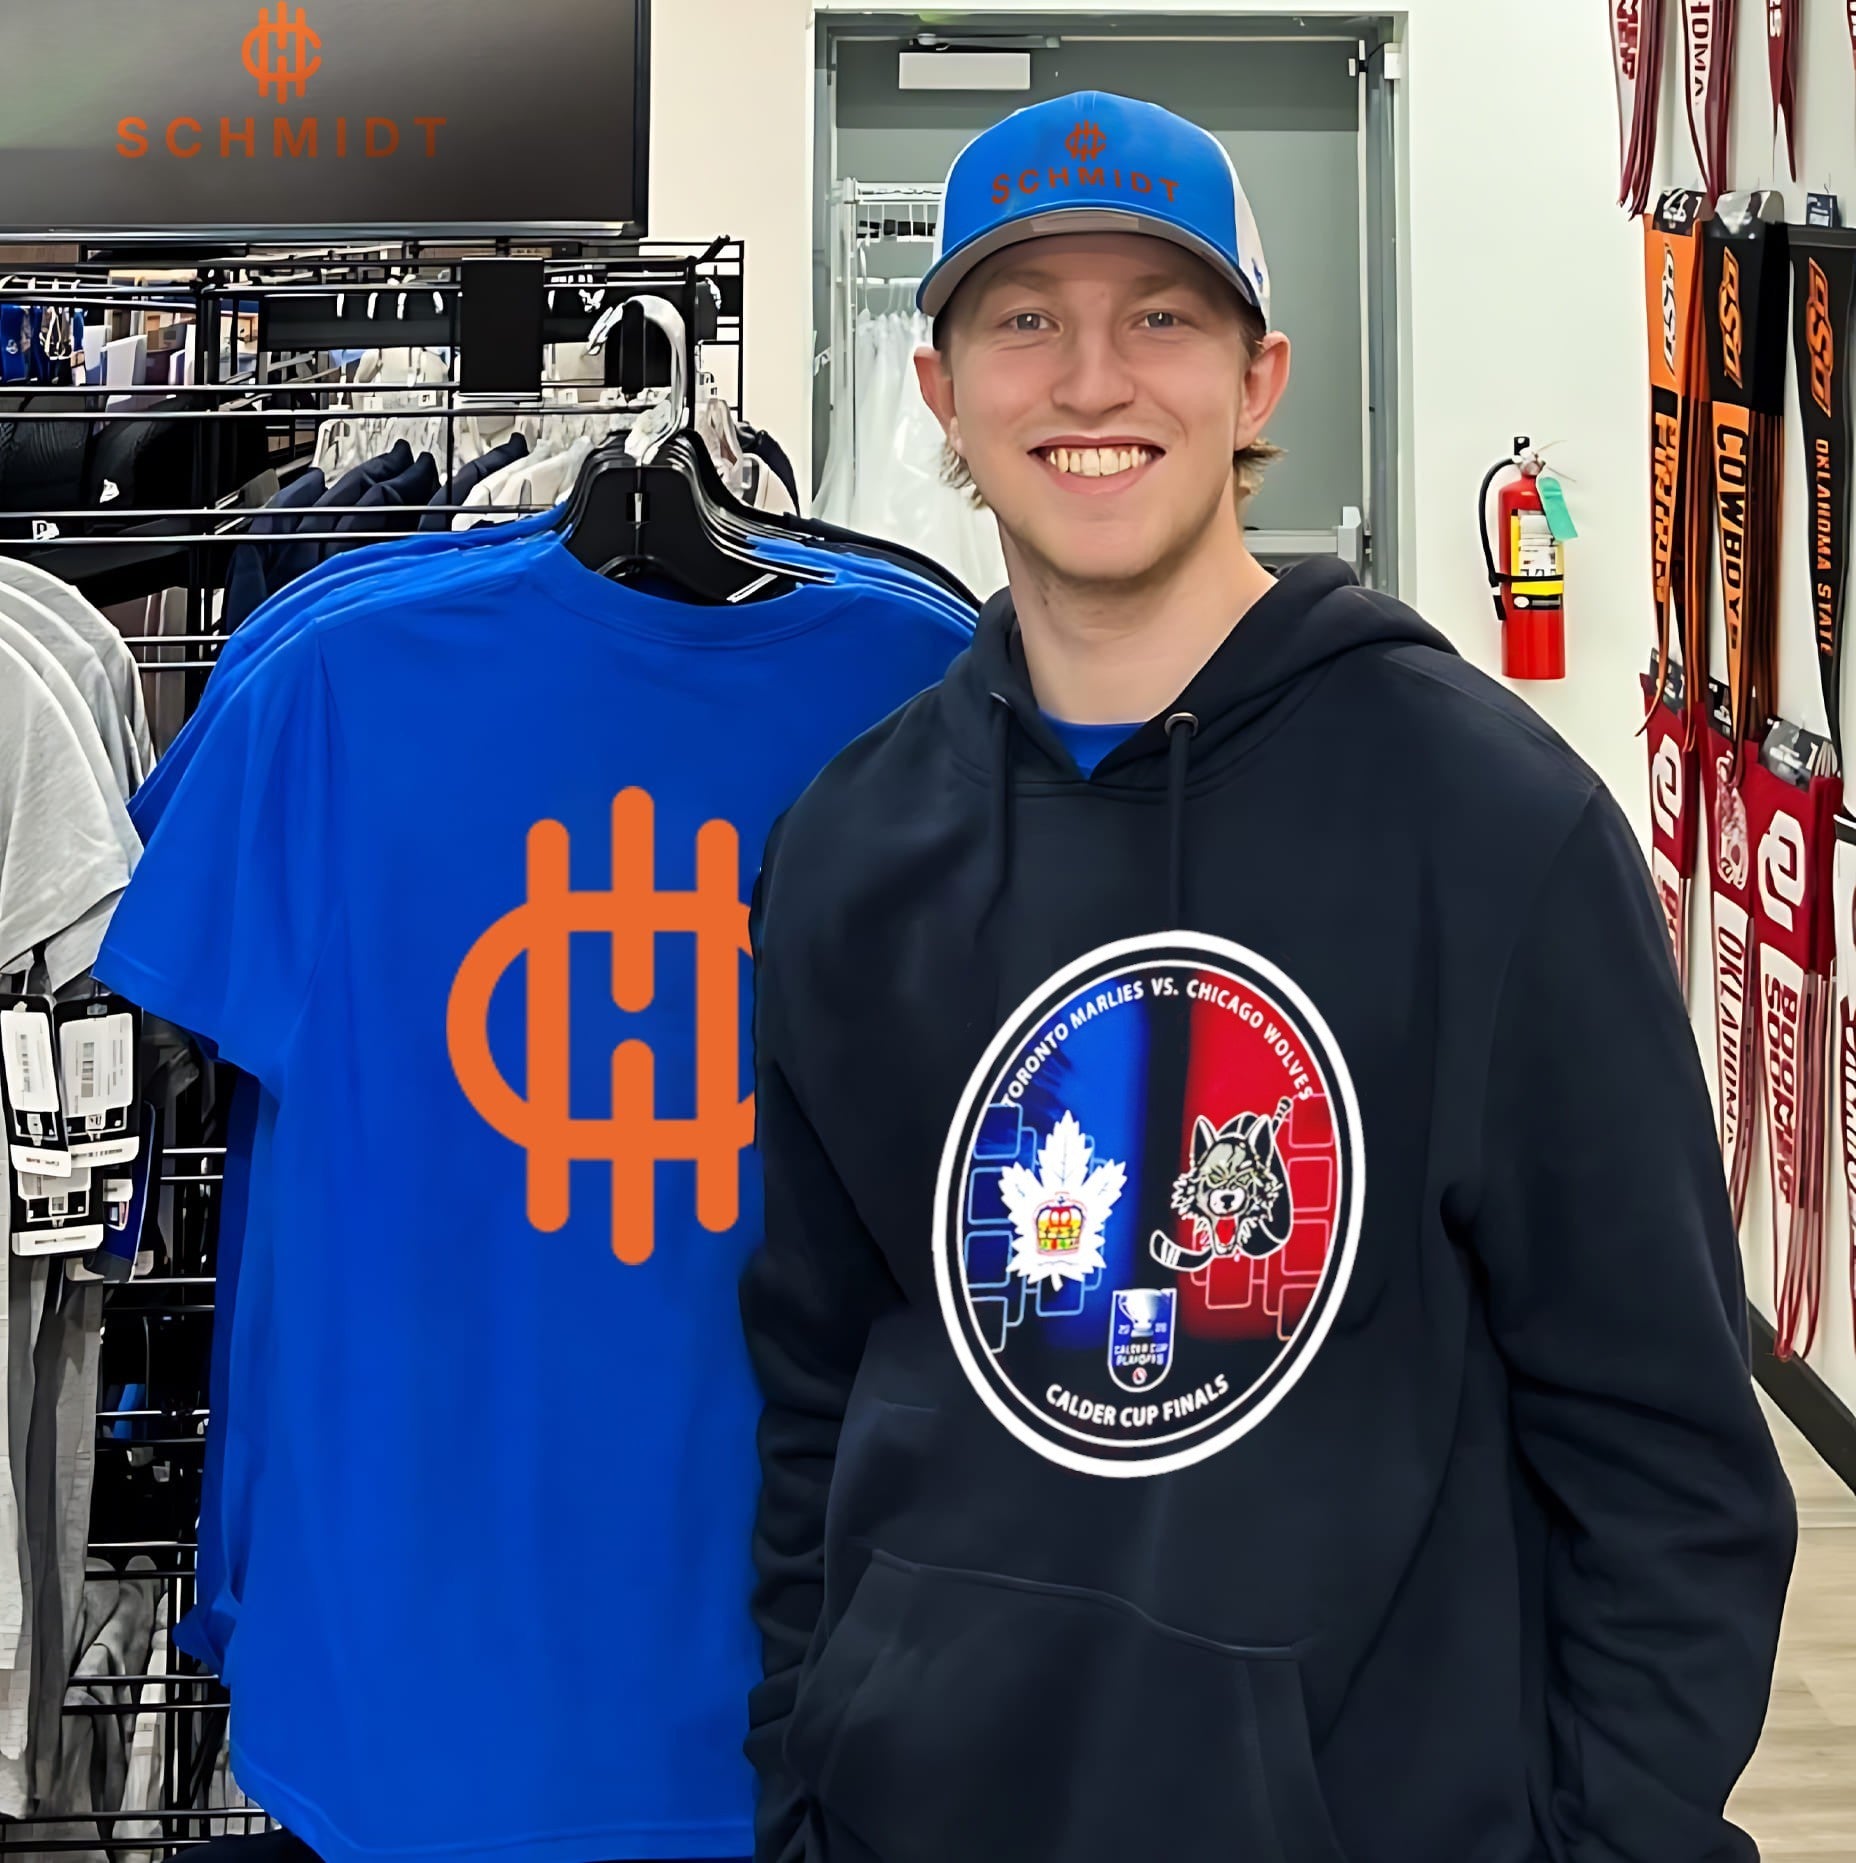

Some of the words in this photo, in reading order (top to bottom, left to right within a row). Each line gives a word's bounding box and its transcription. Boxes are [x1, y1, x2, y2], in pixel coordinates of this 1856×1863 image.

[115, 116, 447, 159] SCHMIDT
[991, 167, 1179, 204] SCHMIDT
[1815, 438, 1832, 571] OKLAHOMA
[1001, 1023, 1070, 1108] TORONTO
[1070, 981, 1144, 1029] MARLIES
[1151, 977, 1179, 997] VS.
[1186, 979, 1264, 1029] CHICAGO
[1263, 1023, 1313, 1101] WOLVES
[1717, 925, 1745, 1145] OKLAHOMA
[1045, 1383, 1117, 1427] CALDER
[1119, 1404, 1159, 1428] CUP
[1162, 1373, 1230, 1422] FINALS
